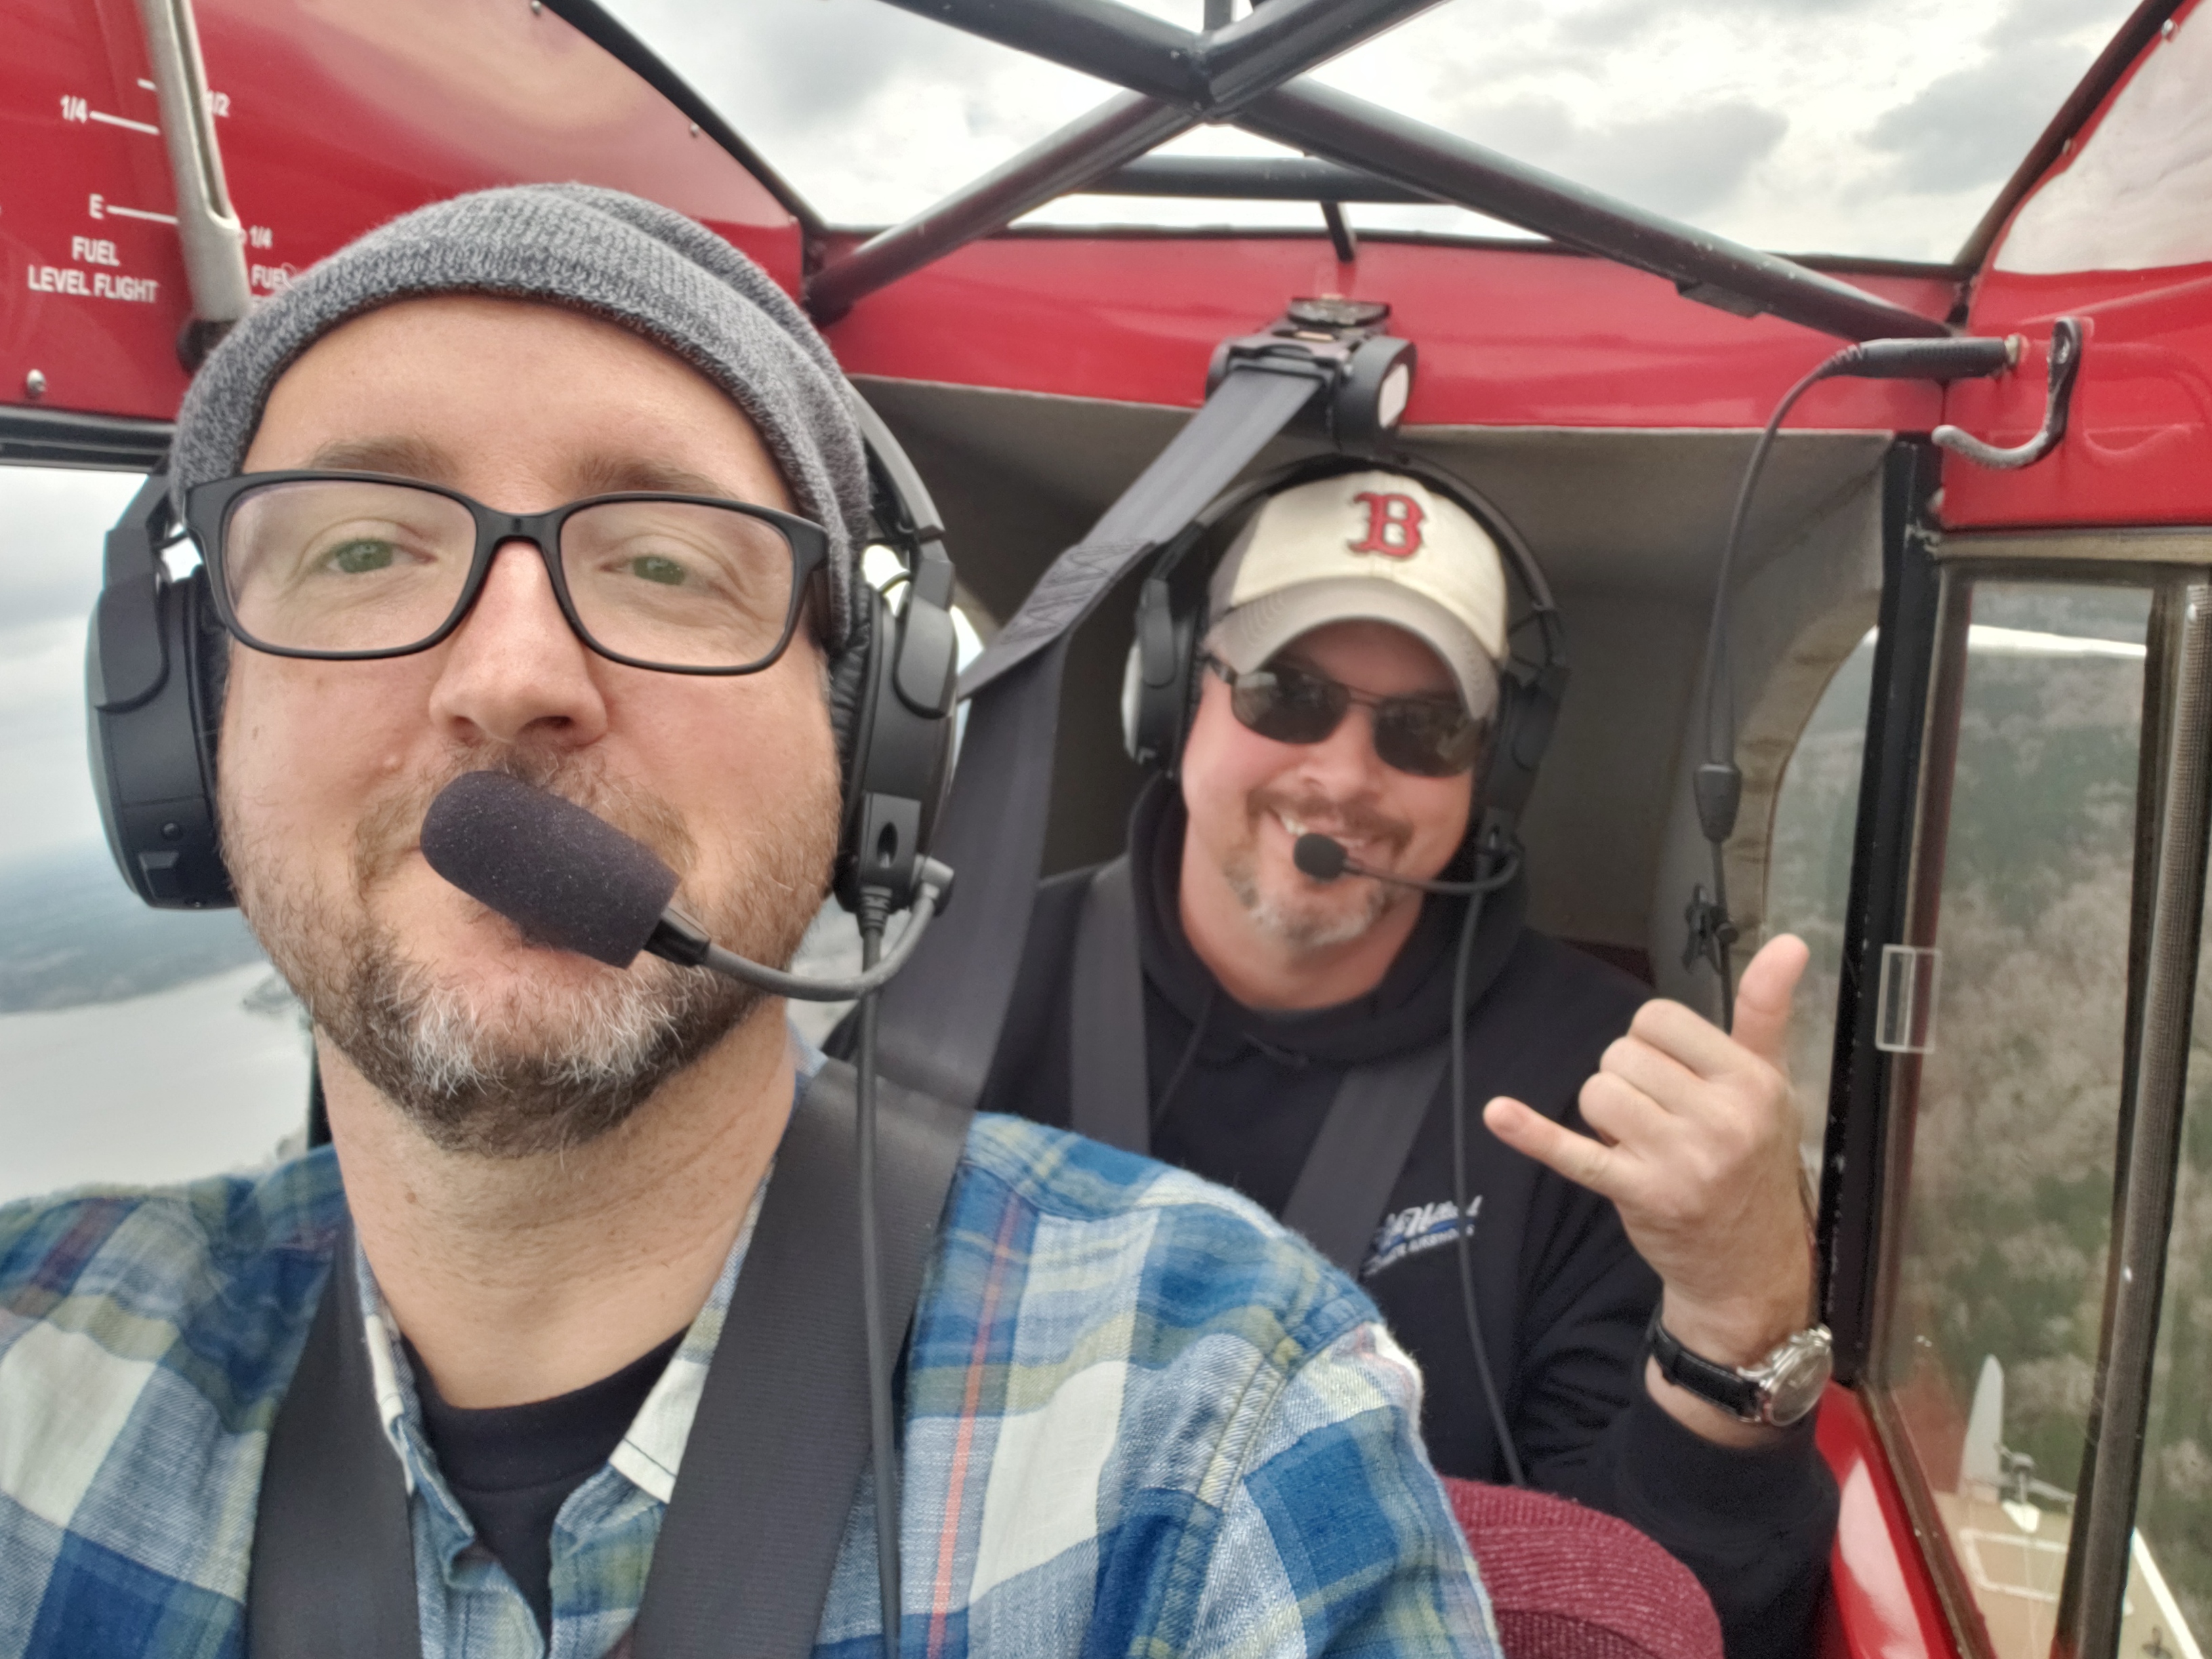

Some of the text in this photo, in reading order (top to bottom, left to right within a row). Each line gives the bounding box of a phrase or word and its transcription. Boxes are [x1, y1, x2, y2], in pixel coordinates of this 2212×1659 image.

[60, 95, 87, 123] 1/4
[89, 194, 104, 219] E
[72, 235, 120, 266] FUEL
[28, 265, 159, 303] LEVEL FLIGHT
[1348, 491, 1426, 559] B
